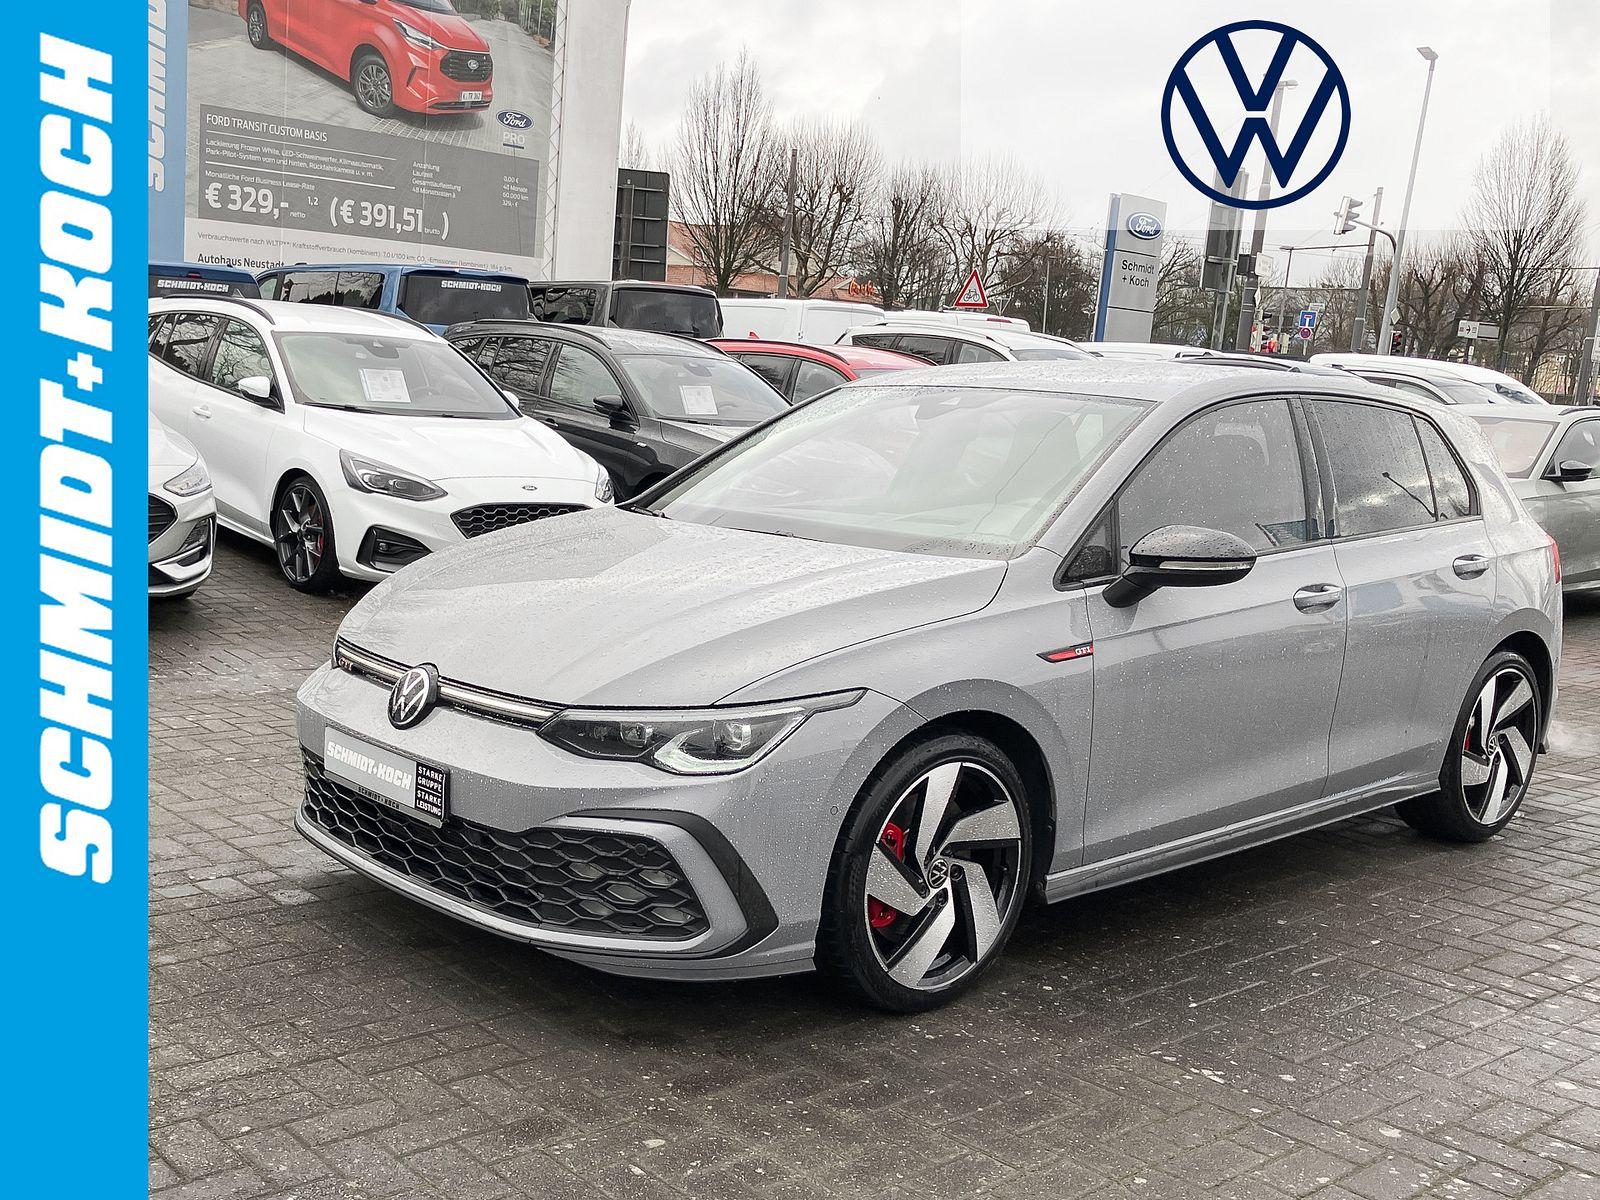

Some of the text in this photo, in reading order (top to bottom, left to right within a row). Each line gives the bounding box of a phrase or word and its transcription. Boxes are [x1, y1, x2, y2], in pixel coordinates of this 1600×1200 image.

[206, 113, 328, 142] FORD TRANSIT CUSTOM BASIS
[502, 131, 525, 145] PRO
[205, 169, 240, 181] Monatliche
[240, 174, 255, 183] Ford
[255, 176, 282, 187] Business
[205, 182, 223, 208] €
[227, 184, 289, 220] 329,-
[289, 210, 306, 219] netto
[307, 195, 319, 206] 1,2
[359, 201, 423, 234] 391,51
[197, 231, 249, 243] Verbrauchswerte
[249, 237, 264, 245] nach
[292, 242, 346, 254] Kraftstoffverbrauch
[197, 253, 285, 269] Autohaus Neustadt
[1121, 259, 1155, 275] Schmidt
[156, 279, 230, 293] SCHMIDT+KOCH
[440, 279, 502, 292] SCHMIDT+KOCH
[1129, 274, 1149, 288] Koch
[1074, 646, 1091, 656] GTI
[326, 741, 413, 790] SCHMIDT+KOCH
[418, 766, 443, 782] STARKE
[417, 776, 442, 792] GRUPPE
[417, 790, 441, 806] STARKE
[416, 799, 442, 816] LEISTUNG
